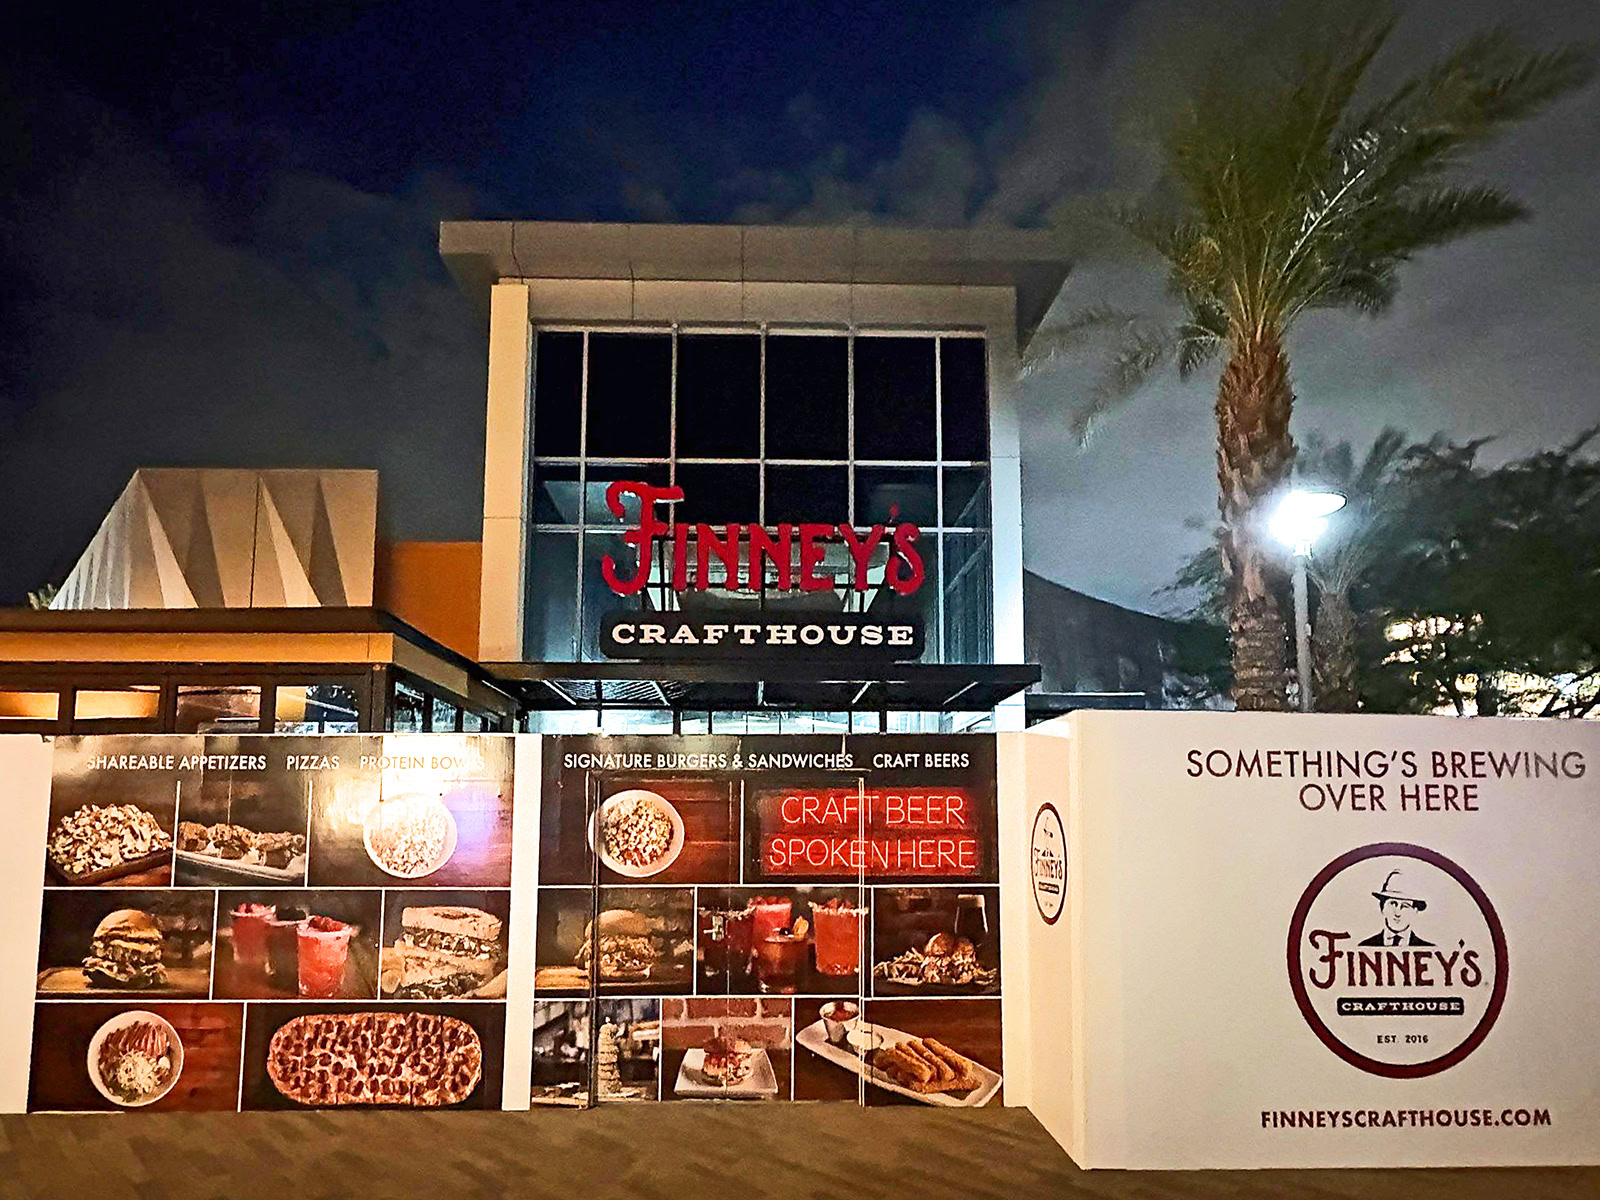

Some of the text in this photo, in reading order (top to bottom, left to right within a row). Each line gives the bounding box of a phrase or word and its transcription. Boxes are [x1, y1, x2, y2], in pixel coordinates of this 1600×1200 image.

[602, 480, 925, 596] FINNEY'S
[611, 622, 914, 646] CRAFTHOUSE
[87, 755, 267, 770] SHAREABLE APPETIZERS
[286, 755, 340, 770] PIZZAS
[360, 756, 486, 770] PROTEIN BOWS
[563, 753, 854, 768] SIGNATURE BURGERS & SANDWICHES
[872, 753, 970, 768] CRAFT BEERS
[1186, 750, 1587, 780] SOMETHING'S BREWING
[1299, 783, 1479, 811] OVER HERE
[781, 796, 965, 824] CRAFT BEER
[769, 838, 976, 868] SPOKEN HERE
[1308, 929, 1483, 990] FINNEY'S
[1341, 1001, 1461, 1012] CRAFTHOUSE
[1404, 1034, 1429, 1044] 2016
[1261, 1109, 1552, 1128] FINNEYSCRAFTHOUSE.COM
